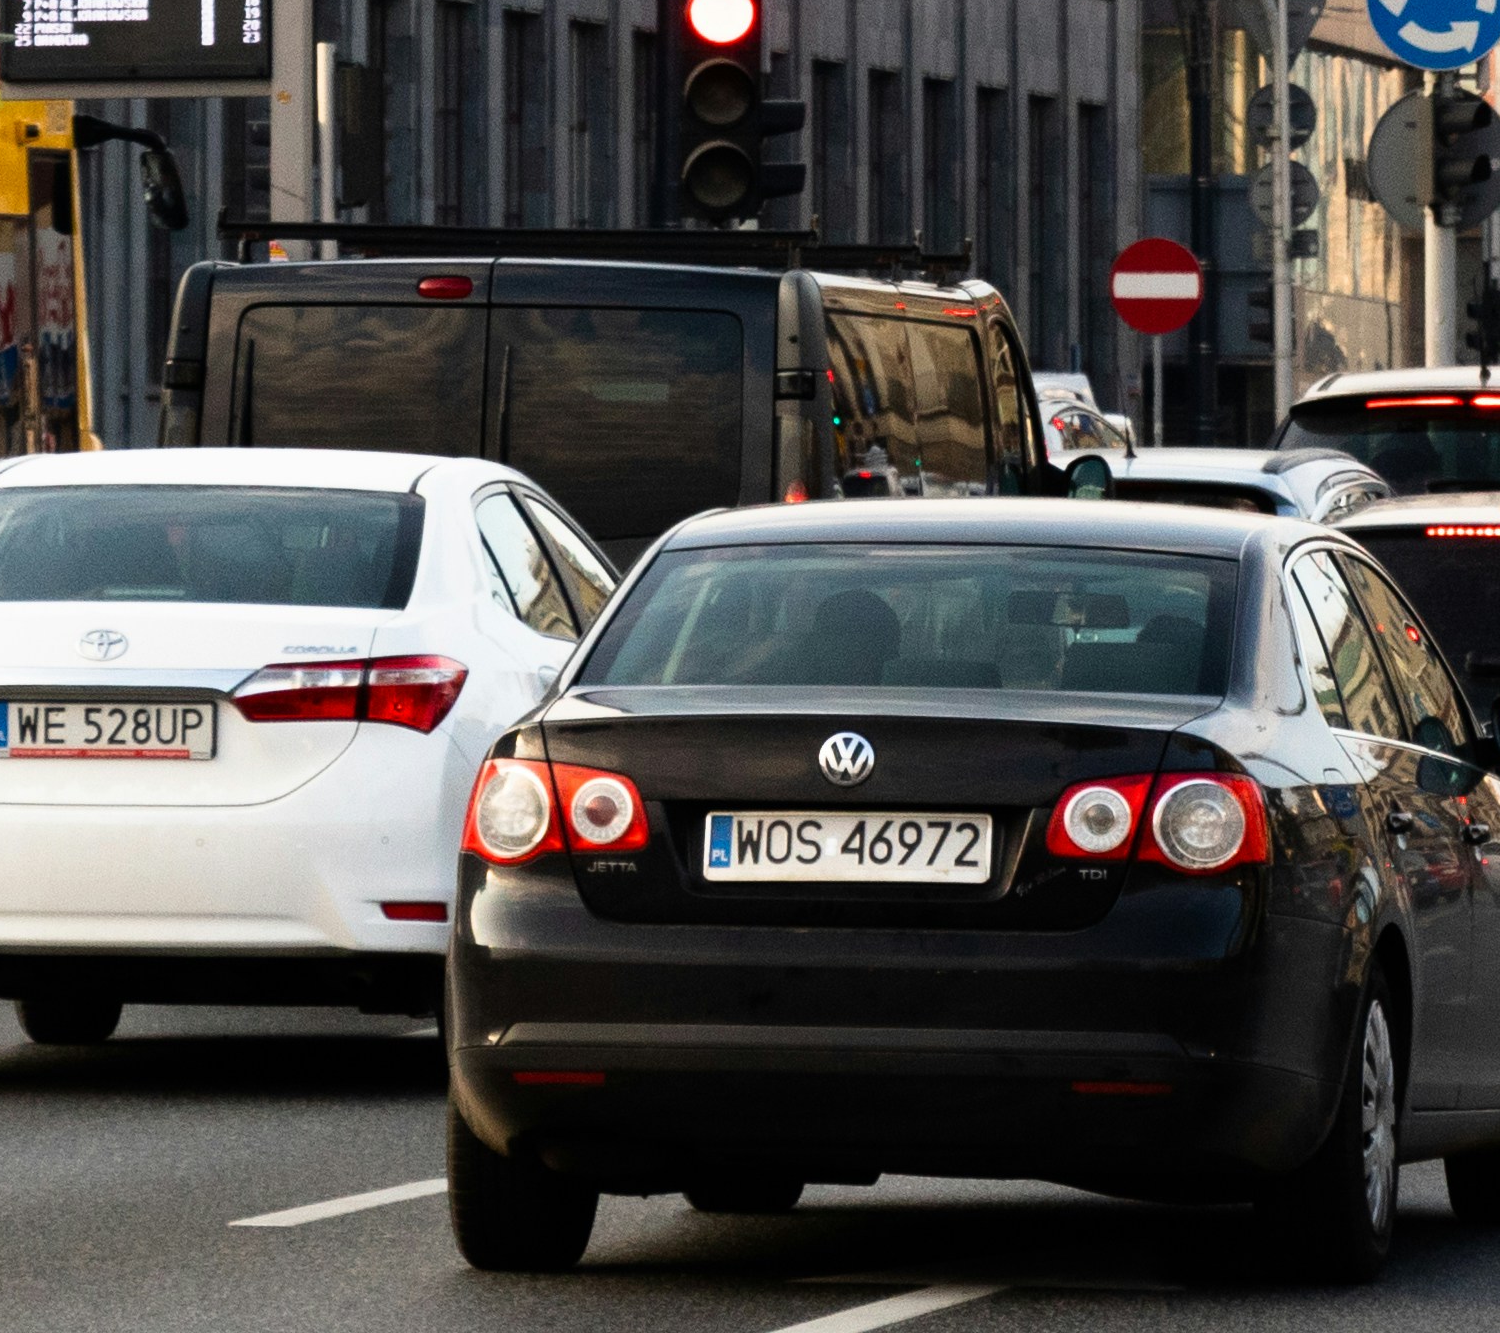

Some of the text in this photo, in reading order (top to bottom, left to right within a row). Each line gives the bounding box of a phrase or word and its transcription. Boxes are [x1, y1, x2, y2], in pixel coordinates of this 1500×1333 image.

[22, 0, 32, 10] 7
[22, 10, 33, 22] 9
[14, 22, 33, 35] 22
[14, 34, 33, 47] 25
[17, 707, 66, 744] WE
[83, 707, 204, 745] 528UP
[736, 820, 822, 866] WOS
[839, 821, 980, 867] 46972
[586, 860, 638, 874] JETTA
[1078, 869, 1108, 880] TDI
